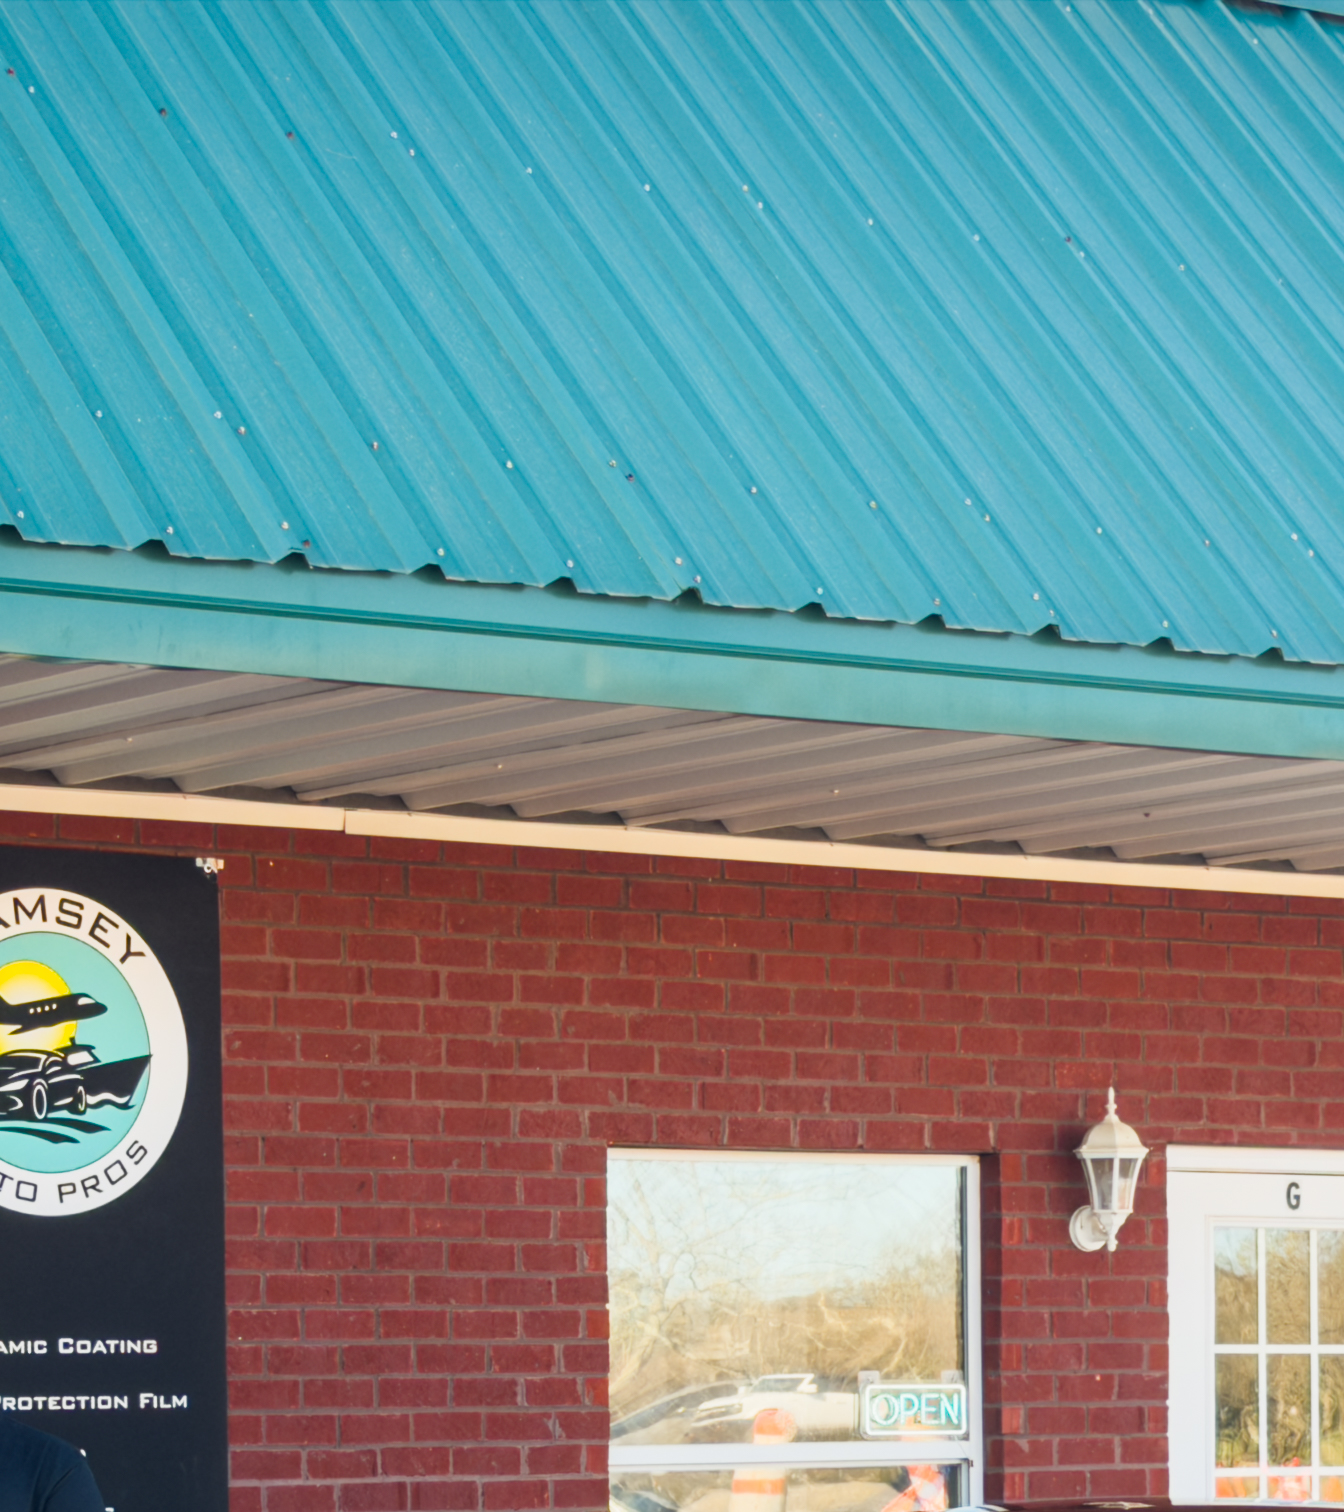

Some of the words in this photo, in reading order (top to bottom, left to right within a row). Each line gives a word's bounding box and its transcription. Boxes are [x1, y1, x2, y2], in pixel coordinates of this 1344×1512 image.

[58, 1139, 148, 1203] PROS
[1286, 1181, 1301, 1210] G
[871, 1393, 959, 1426] OPEN
